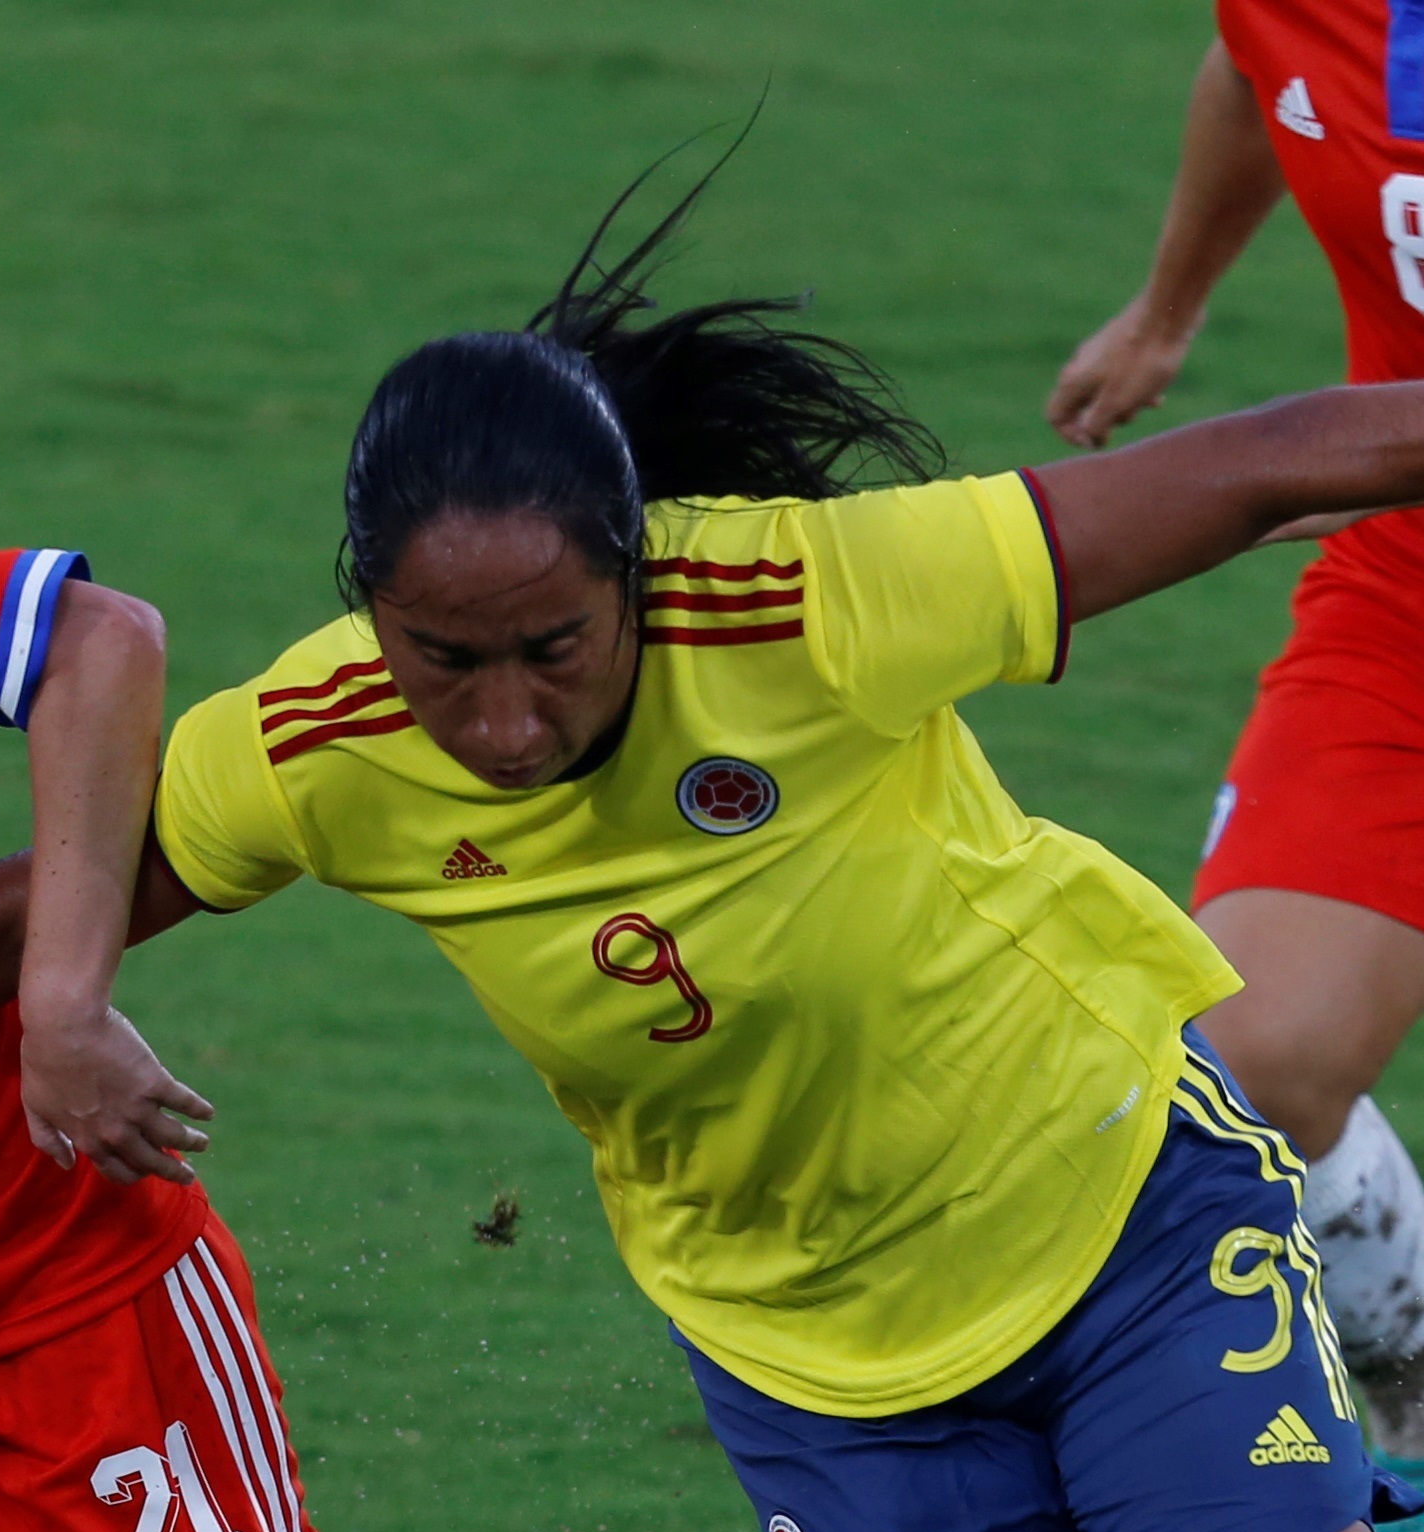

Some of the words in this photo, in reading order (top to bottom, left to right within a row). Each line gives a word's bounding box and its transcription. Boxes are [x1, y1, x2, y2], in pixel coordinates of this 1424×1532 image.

[441, 860, 508, 880] adidas
[592, 913, 713, 1043] 9
[1209, 1227, 1293, 1373] 9
[1249, 1441, 1331, 1466] adidas
